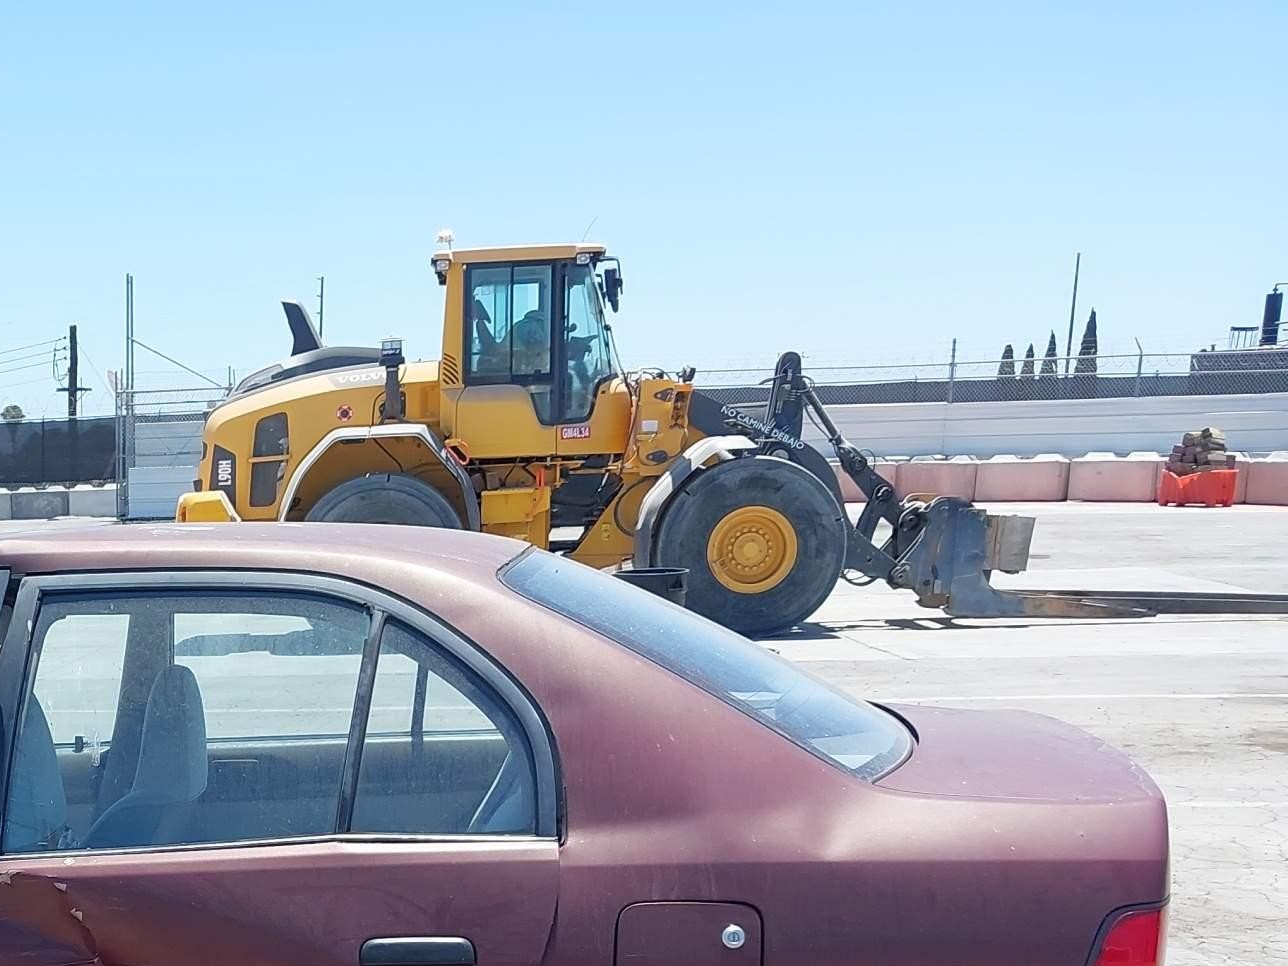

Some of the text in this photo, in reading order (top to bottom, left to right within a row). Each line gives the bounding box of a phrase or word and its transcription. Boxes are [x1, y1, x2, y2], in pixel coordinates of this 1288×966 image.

[336, 371, 386, 384] VOLV
[720, 405, 805, 449] NO CAMINE DEBAJO
[218, 460, 232, 486] L90H
